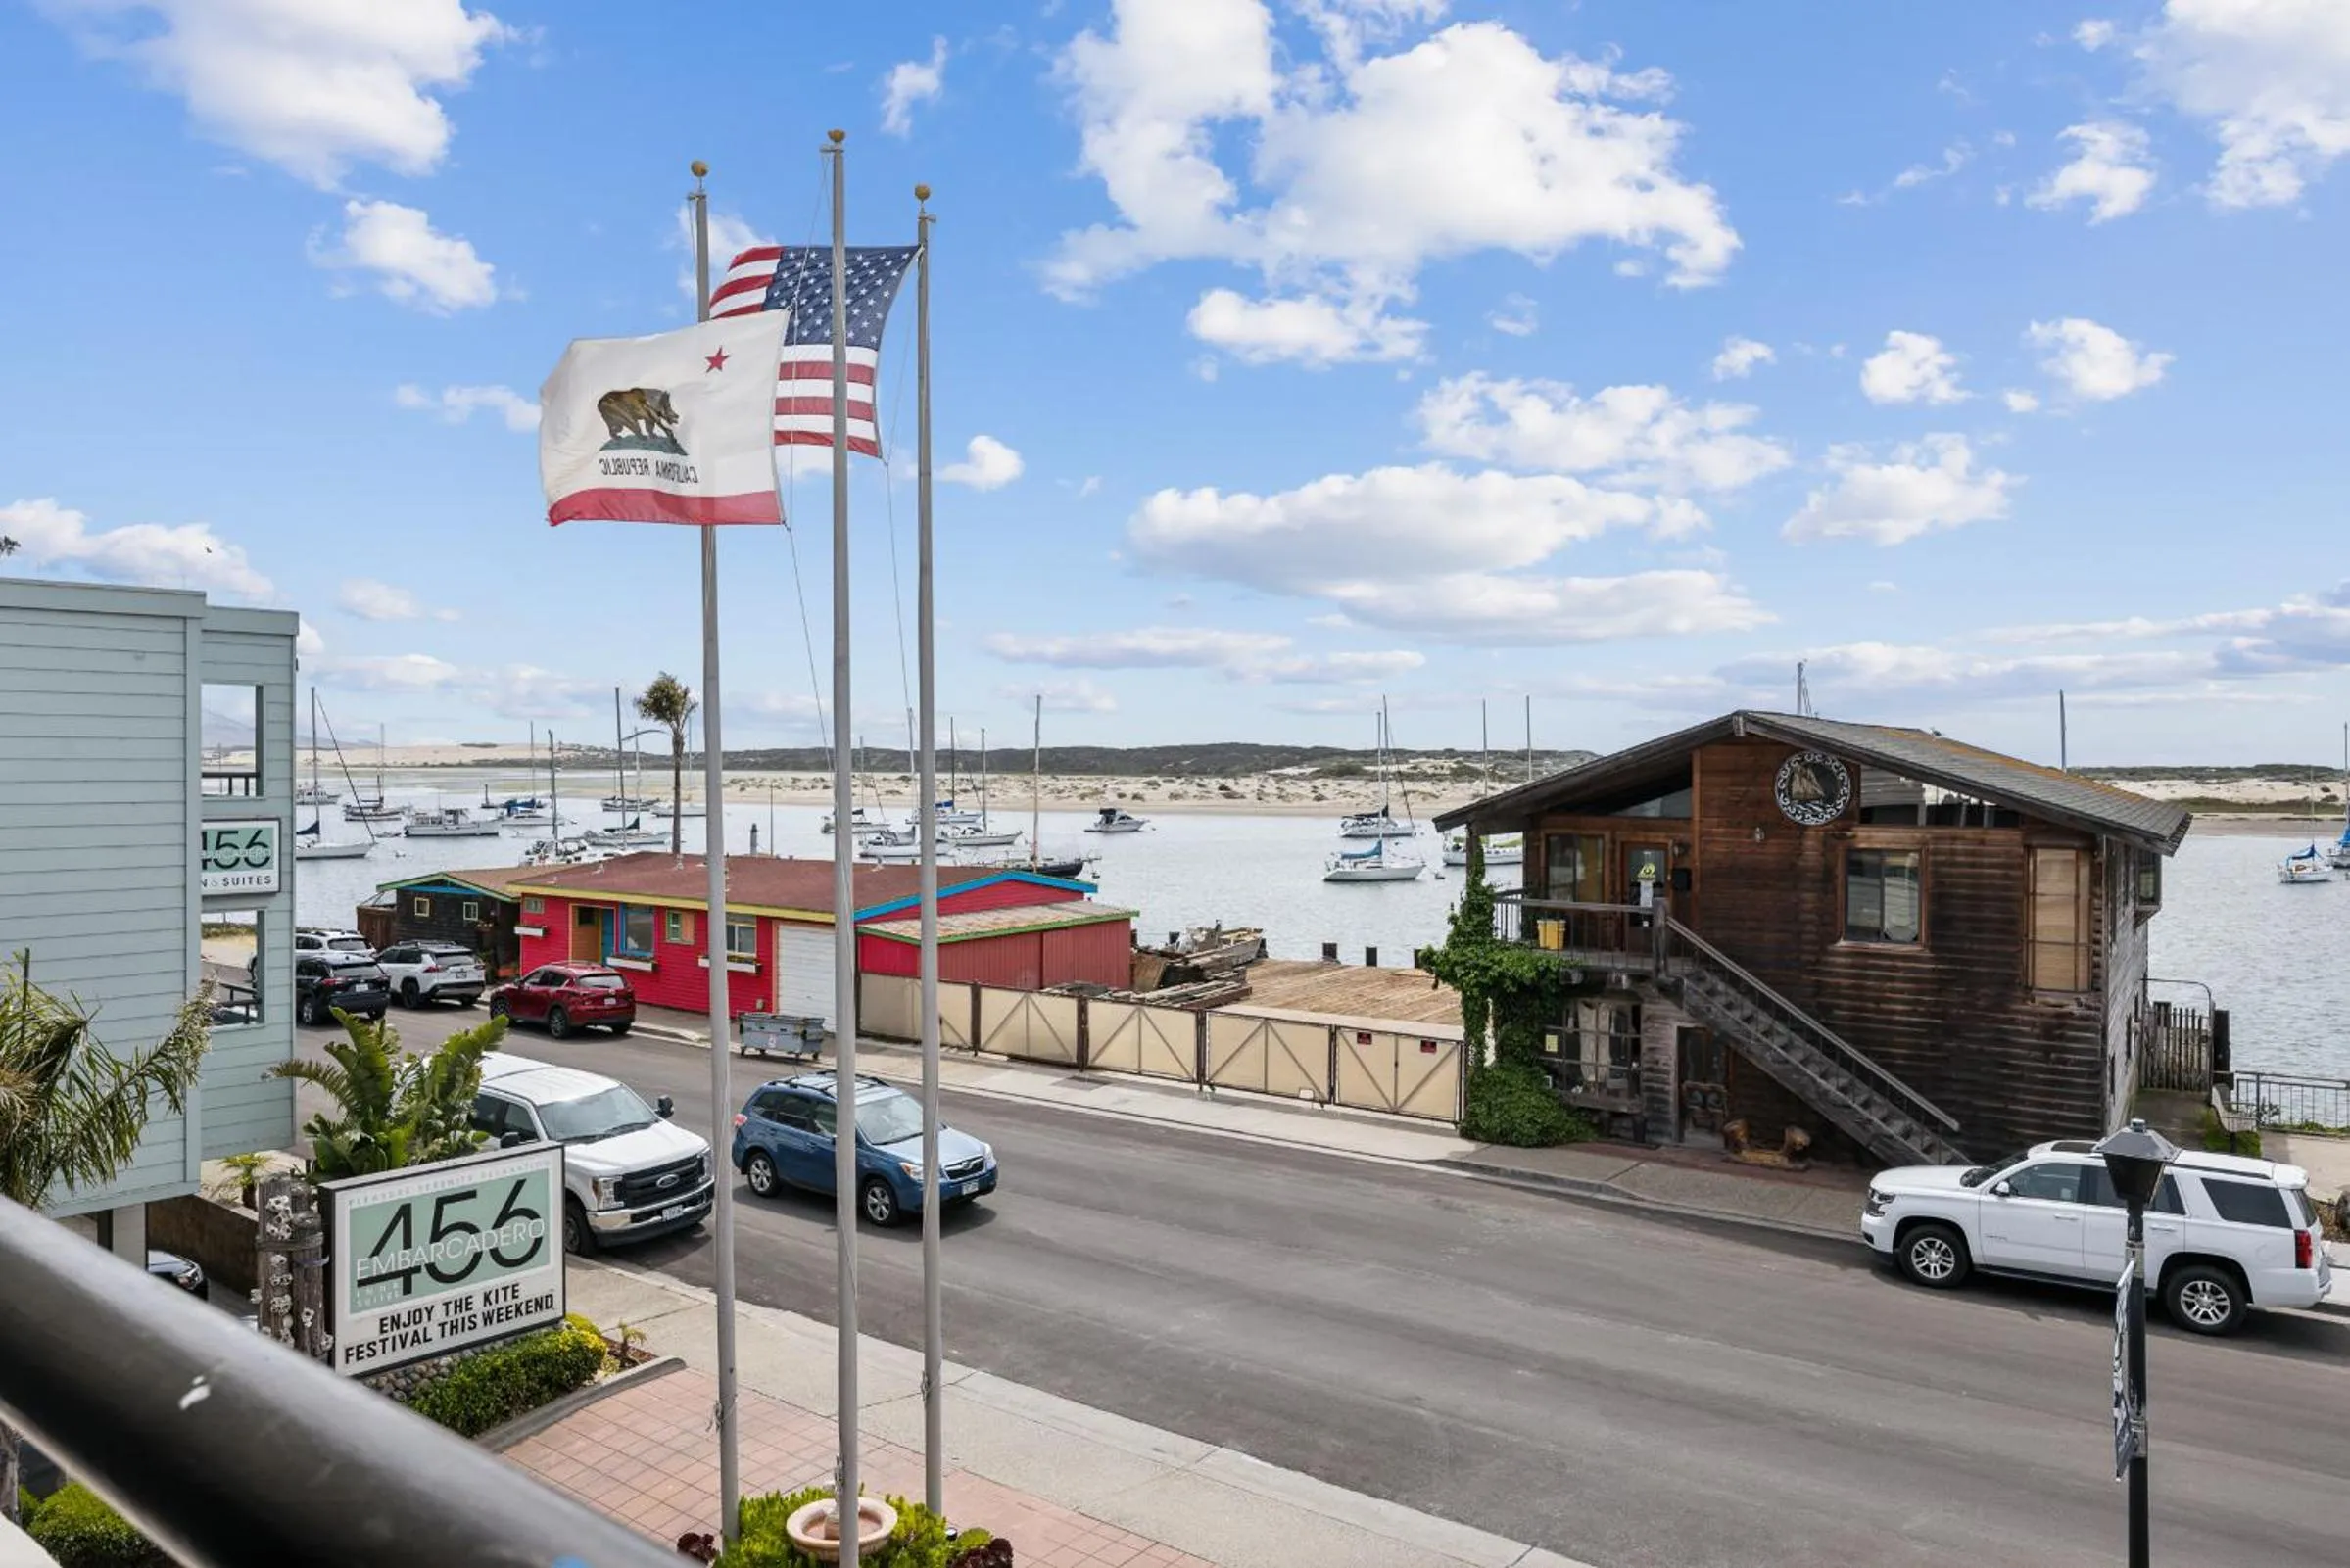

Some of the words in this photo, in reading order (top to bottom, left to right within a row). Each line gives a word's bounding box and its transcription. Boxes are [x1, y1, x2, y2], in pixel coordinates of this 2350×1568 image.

[222, 875, 271, 887] SUITES
[357, 1178, 543, 1296] 456
[357, 1218, 546, 1281] EMBARCADERO
[345, 1327, 433, 1365] FESTIVAL
[438, 1314, 477, 1339] THIS
[482, 1293, 553, 1327] WEEKEND
[379, 1305, 435, 1334] ENJOY
[442, 1295, 474, 1317] THE
[483, 1283, 520, 1307] KITE
